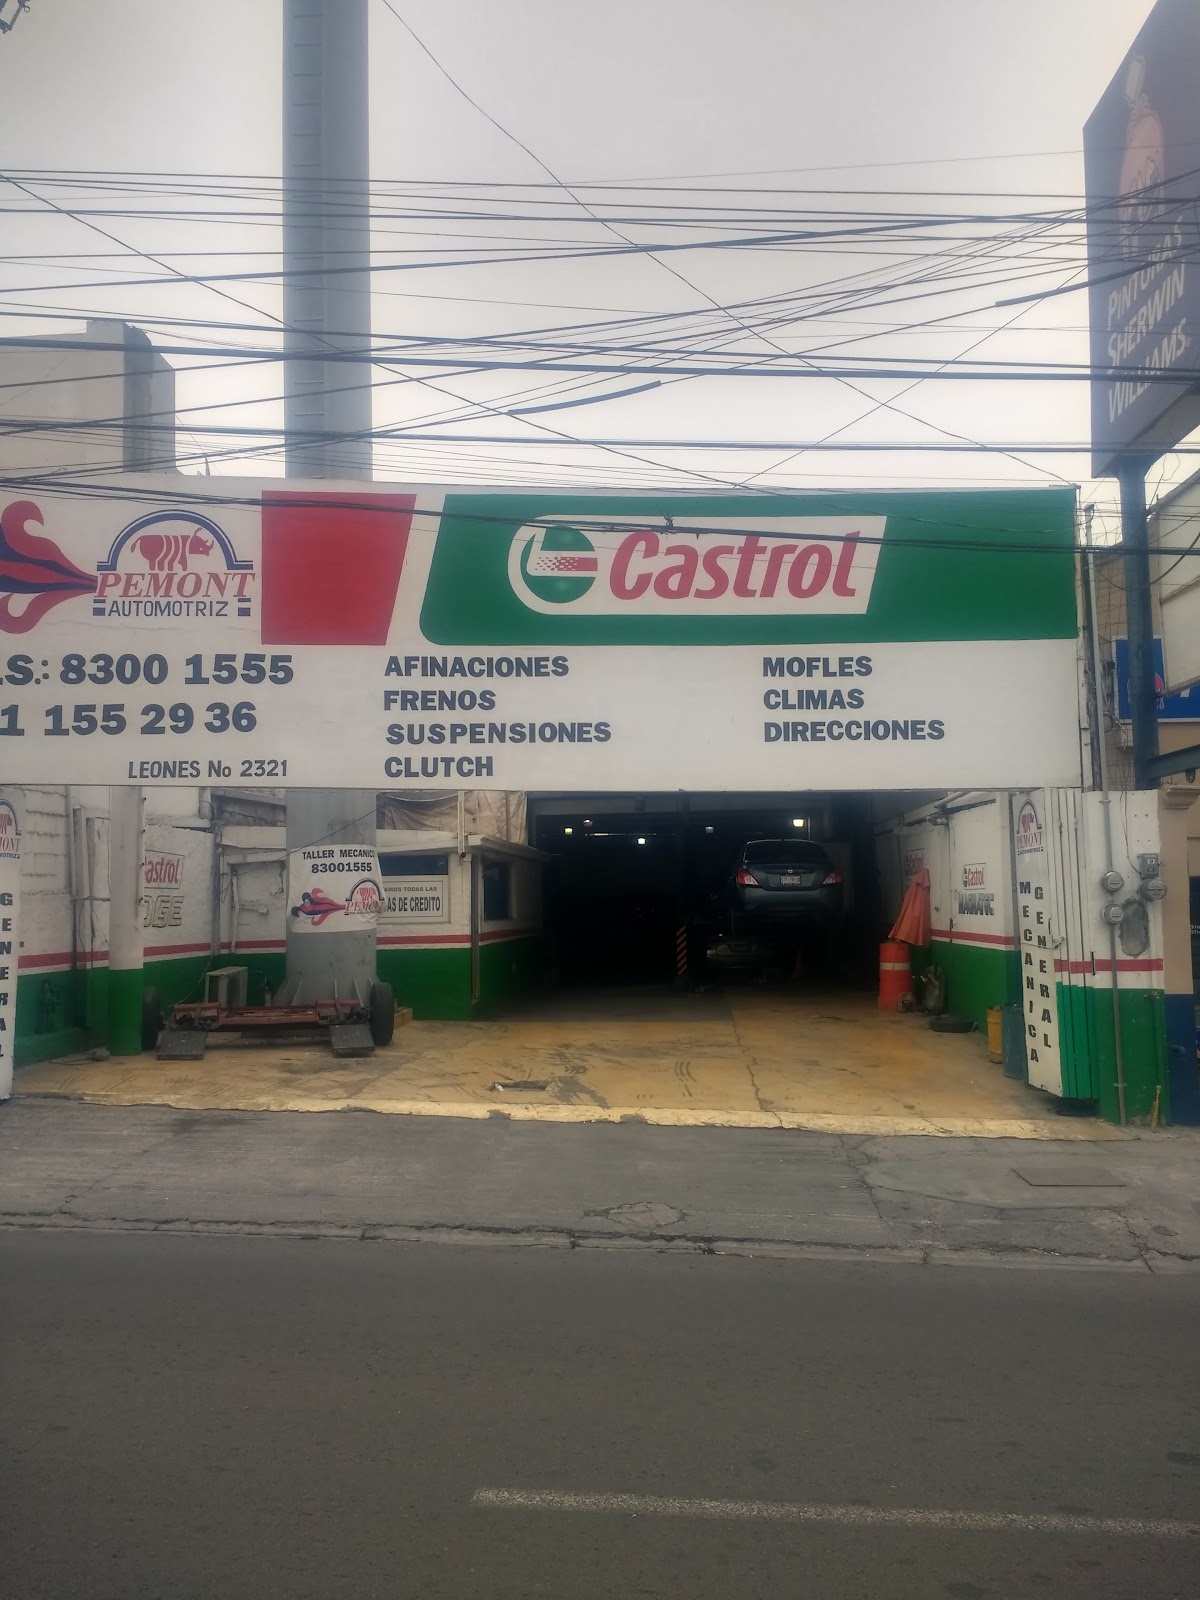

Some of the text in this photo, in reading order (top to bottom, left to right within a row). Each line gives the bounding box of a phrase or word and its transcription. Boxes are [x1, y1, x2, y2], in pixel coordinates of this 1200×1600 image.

[1107, 215, 1183, 332] PINTURAS
[1107, 259, 1185, 374] SHERWIN
[609, 530, 860, 600] Castrol
[94, 572, 256, 598] PEMONT
[108, 601, 228, 616] AUTOMOTRIZ
[0, 653, 294, 686] S.: 8300 1555
[384, 656, 569, 677] AFINACIONES
[762, 656, 873, 678] MOFLES
[384, 690, 497, 711] FRENOS
[763, 688, 865, 710] CLIMAS
[44, 704, 127, 736] 155
[140, 702, 195, 734] 29
[204, 701, 257, 733] 36
[385, 722, 612, 745] SUSPENSIONES
[764, 720, 945, 743] DIRECCIONES
[128, 759, 288, 779] LEONES No 2321
[384, 756, 494, 778] CLUTCH
[303, 850, 335, 860] TALLER
[145, 857, 180, 884] astrol
[311, 862, 373, 874] 83001555
[968, 867, 985, 887] Castrol
[398, 897, 408, 912] DE
[409, 897, 441, 912] CREDITO
[1019, 882, 1039, 1063] MECANICA
[1034, 887, 1052, 1048] GENERAL
